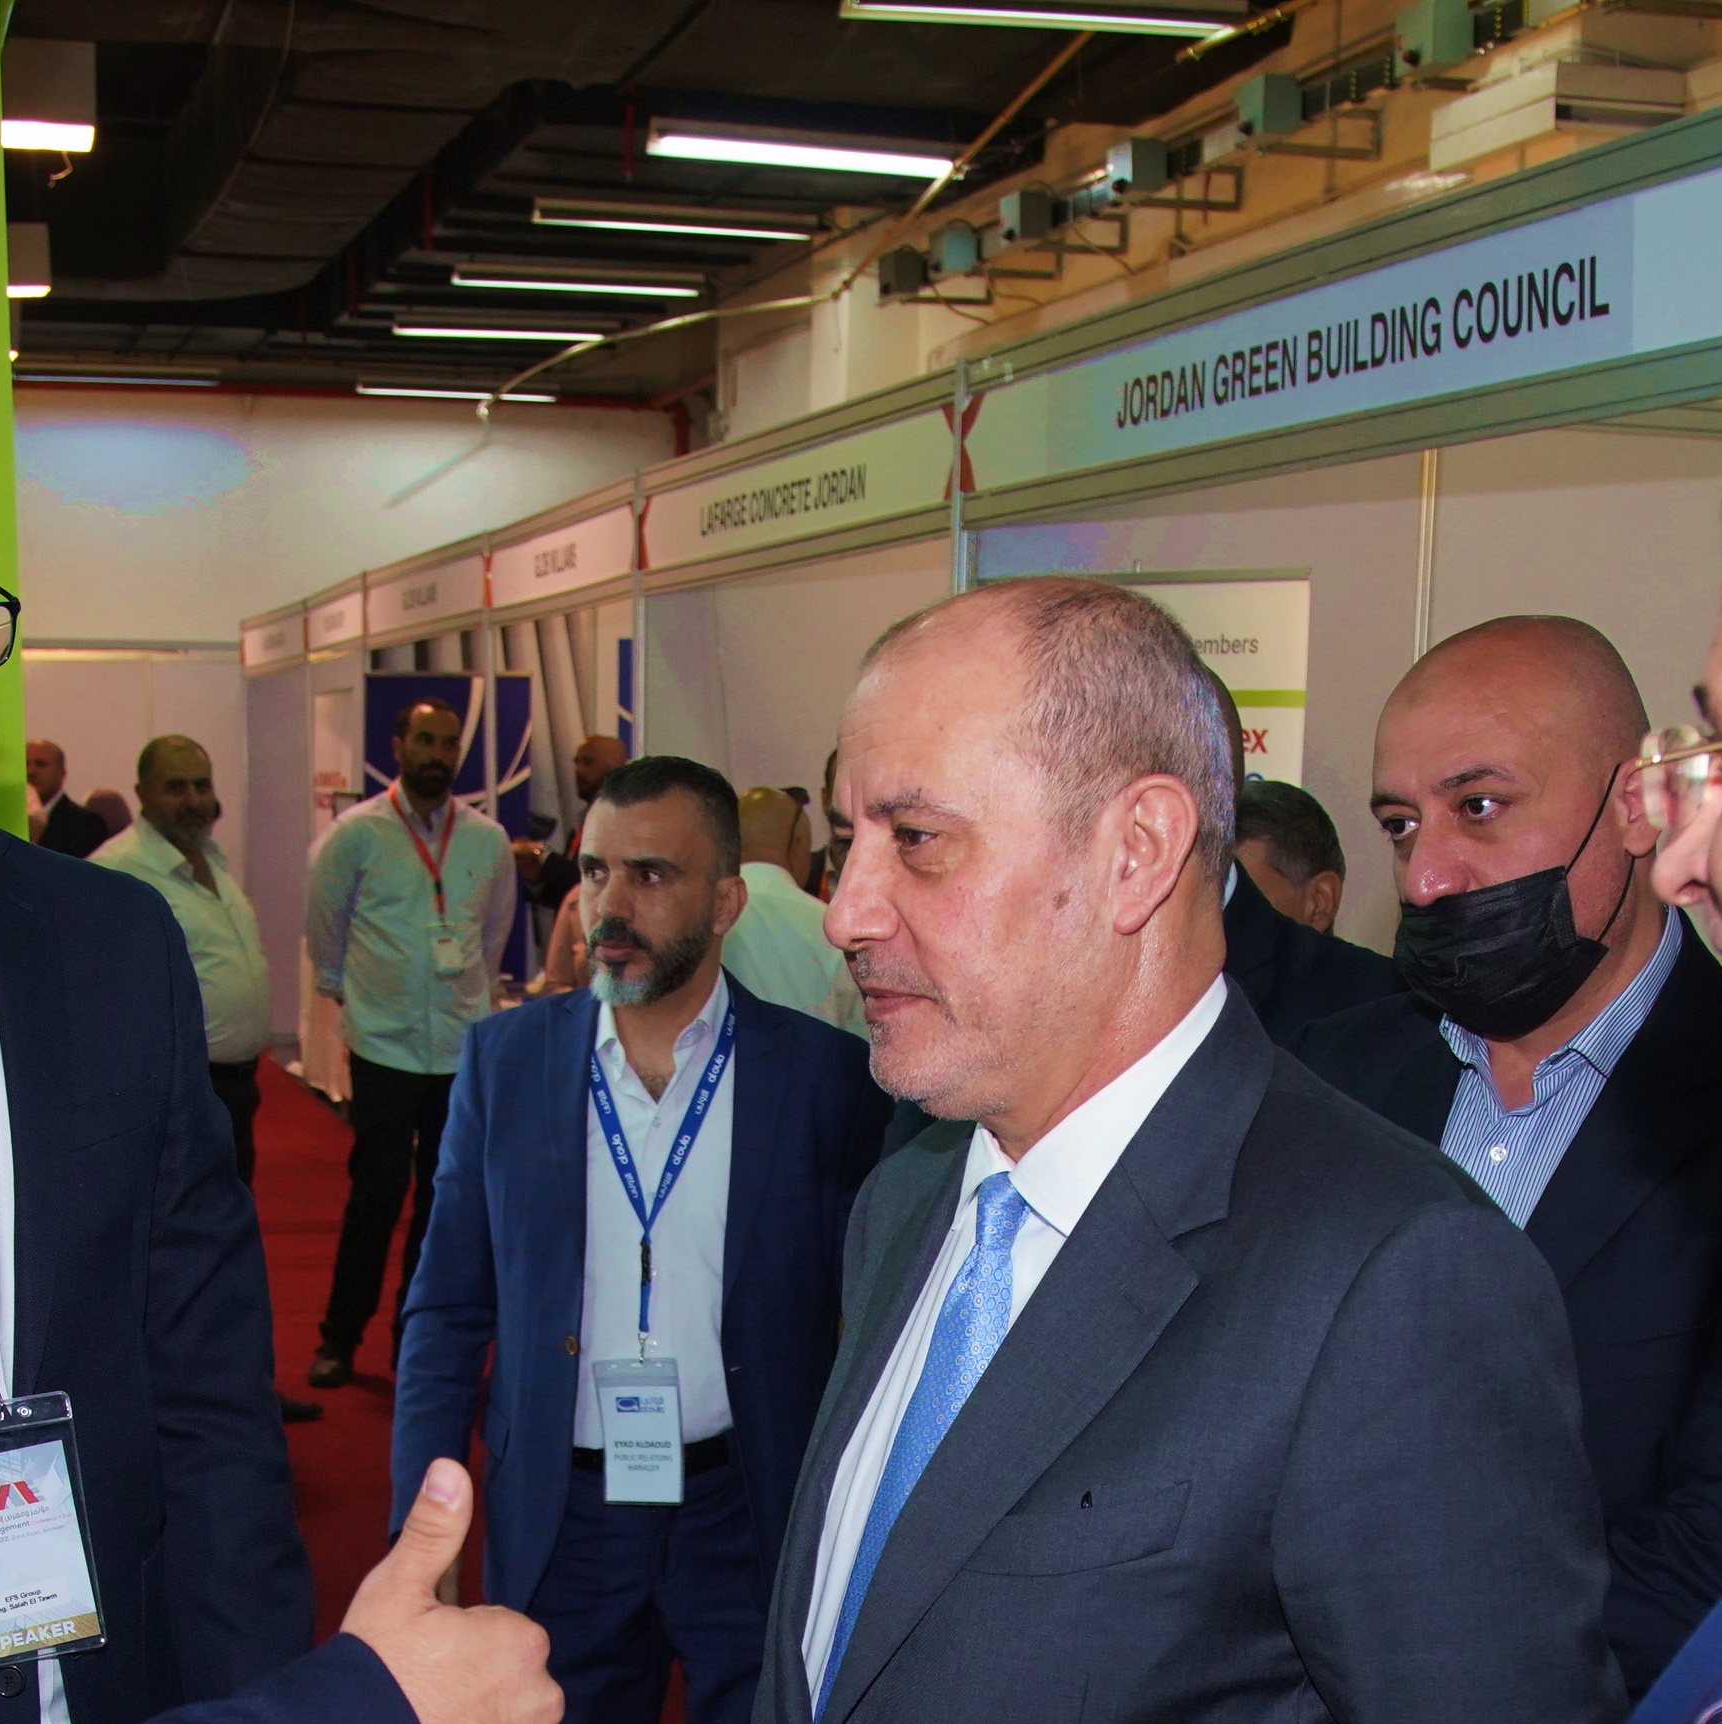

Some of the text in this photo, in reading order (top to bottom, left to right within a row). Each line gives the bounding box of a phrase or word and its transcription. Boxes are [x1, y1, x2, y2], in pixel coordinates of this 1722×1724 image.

[1116, 256, 1610, 429] JORDAN GREEN BUILDING COUNCIL
[700, 464, 867, 537] LAFARGE CONCRETE JORDAN
[1191, 634, 1259, 655] embers
[708, 1054, 726, 1083] aloula
[612, 1134, 629, 1165] aloula
[673, 1134, 692, 1166] aloula
[4, 1589, 42, 1603] EFS Group
[9, 1600, 29, 1611] Salah
[29, 1597, 37, 1605] El
